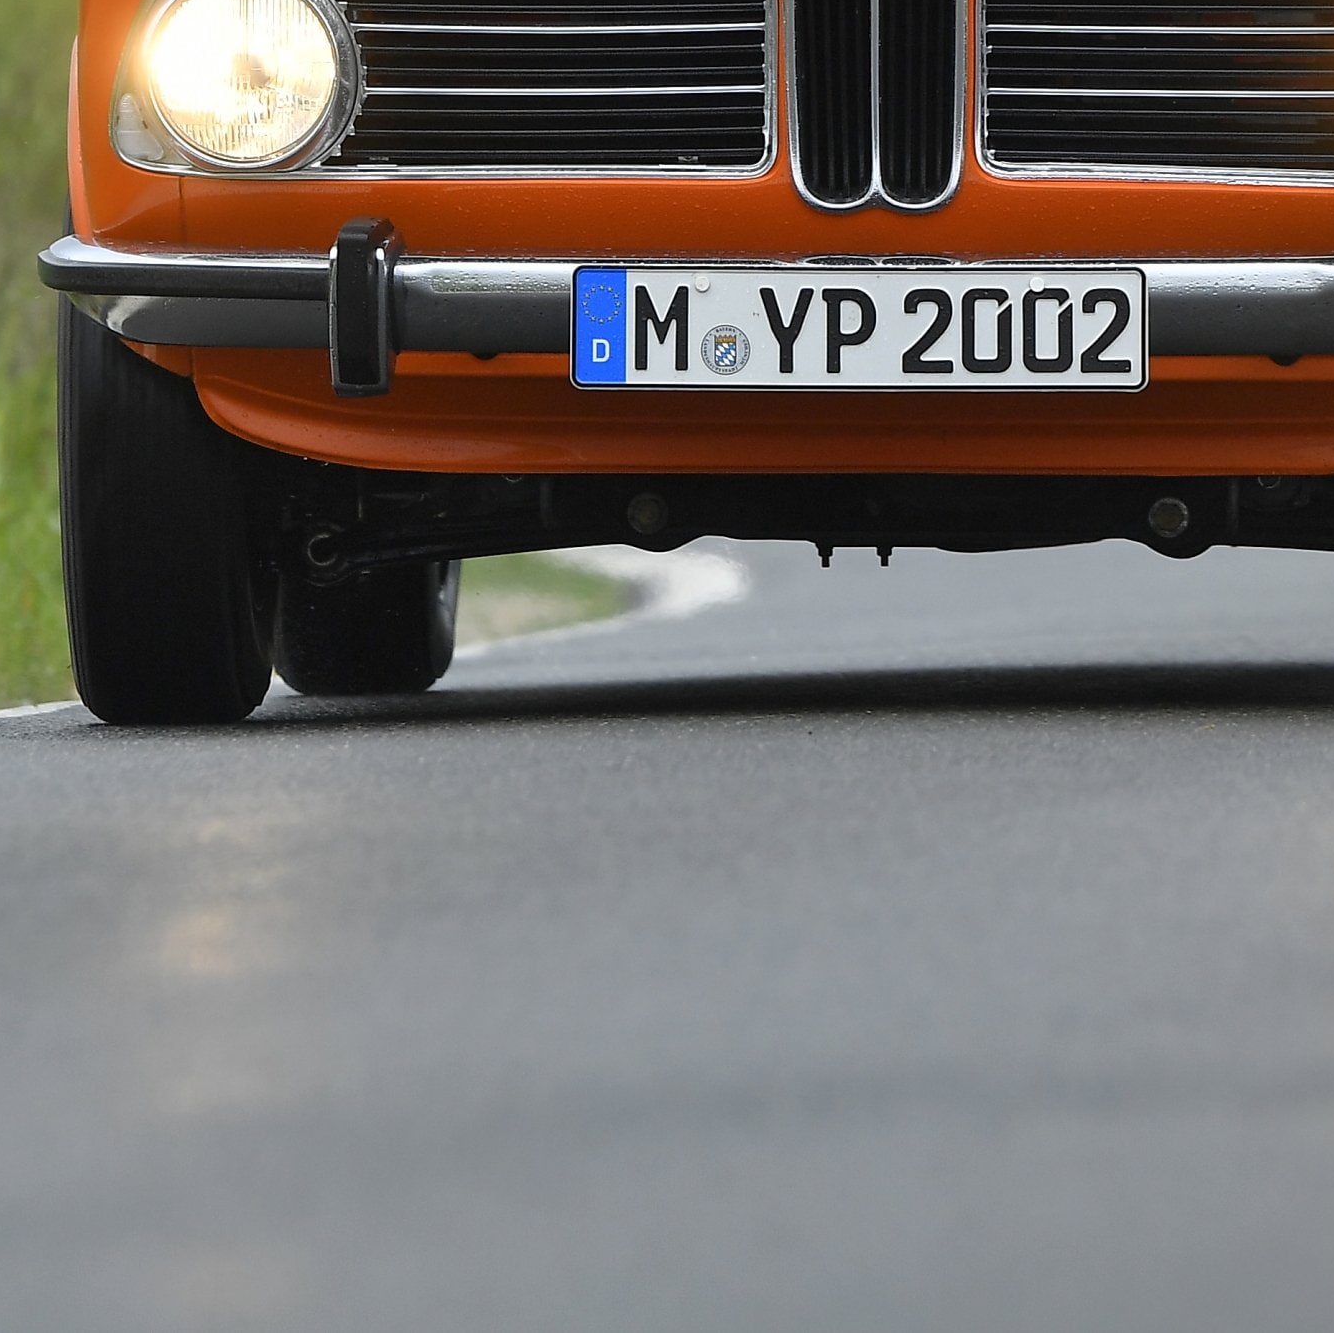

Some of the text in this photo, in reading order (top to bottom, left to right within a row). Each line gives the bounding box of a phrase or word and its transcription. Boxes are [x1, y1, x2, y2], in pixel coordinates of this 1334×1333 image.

[592, 338, 610, 362] D
[634, 285, 1132, 374] M YP 2002
